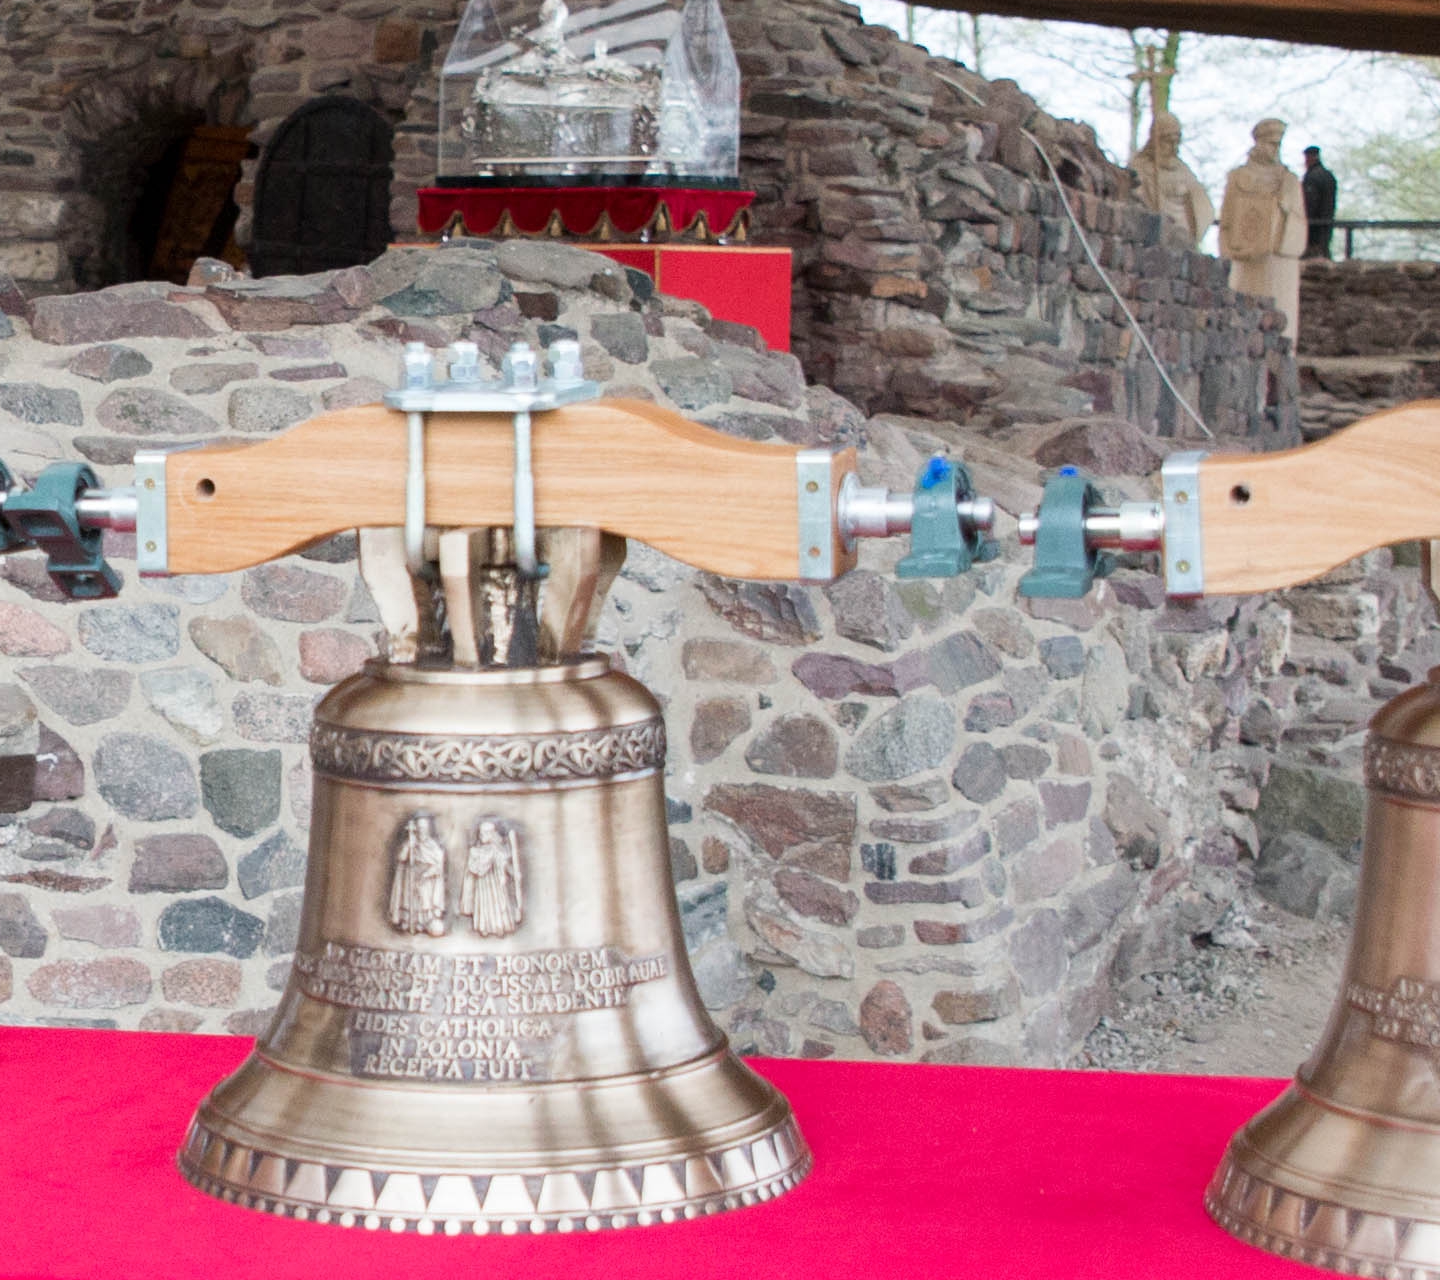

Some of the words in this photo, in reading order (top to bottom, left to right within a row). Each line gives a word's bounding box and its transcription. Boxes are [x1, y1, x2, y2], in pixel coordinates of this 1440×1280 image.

[349, 947, 441, 975] GLORIAM
[454, 955, 484, 975] ET
[495, 949, 608, 975] HONOREM
[411, 973, 439, 995] ET
[452, 973, 561, 995] DUCISSAE
[444, 993, 498, 1017] IPSA
[508, 987, 627, 1014] SUADENTE
[355, 1011, 410, 1034] FIDES
[419, 1017, 553, 1039] CATHOLICA
[378, 1035, 405, 1057] IN
[415, 1038, 521, 1059] POLONIA
[363, 1053, 464, 1080] RECEPTA
[473, 1059, 533, 1081] FUIT
